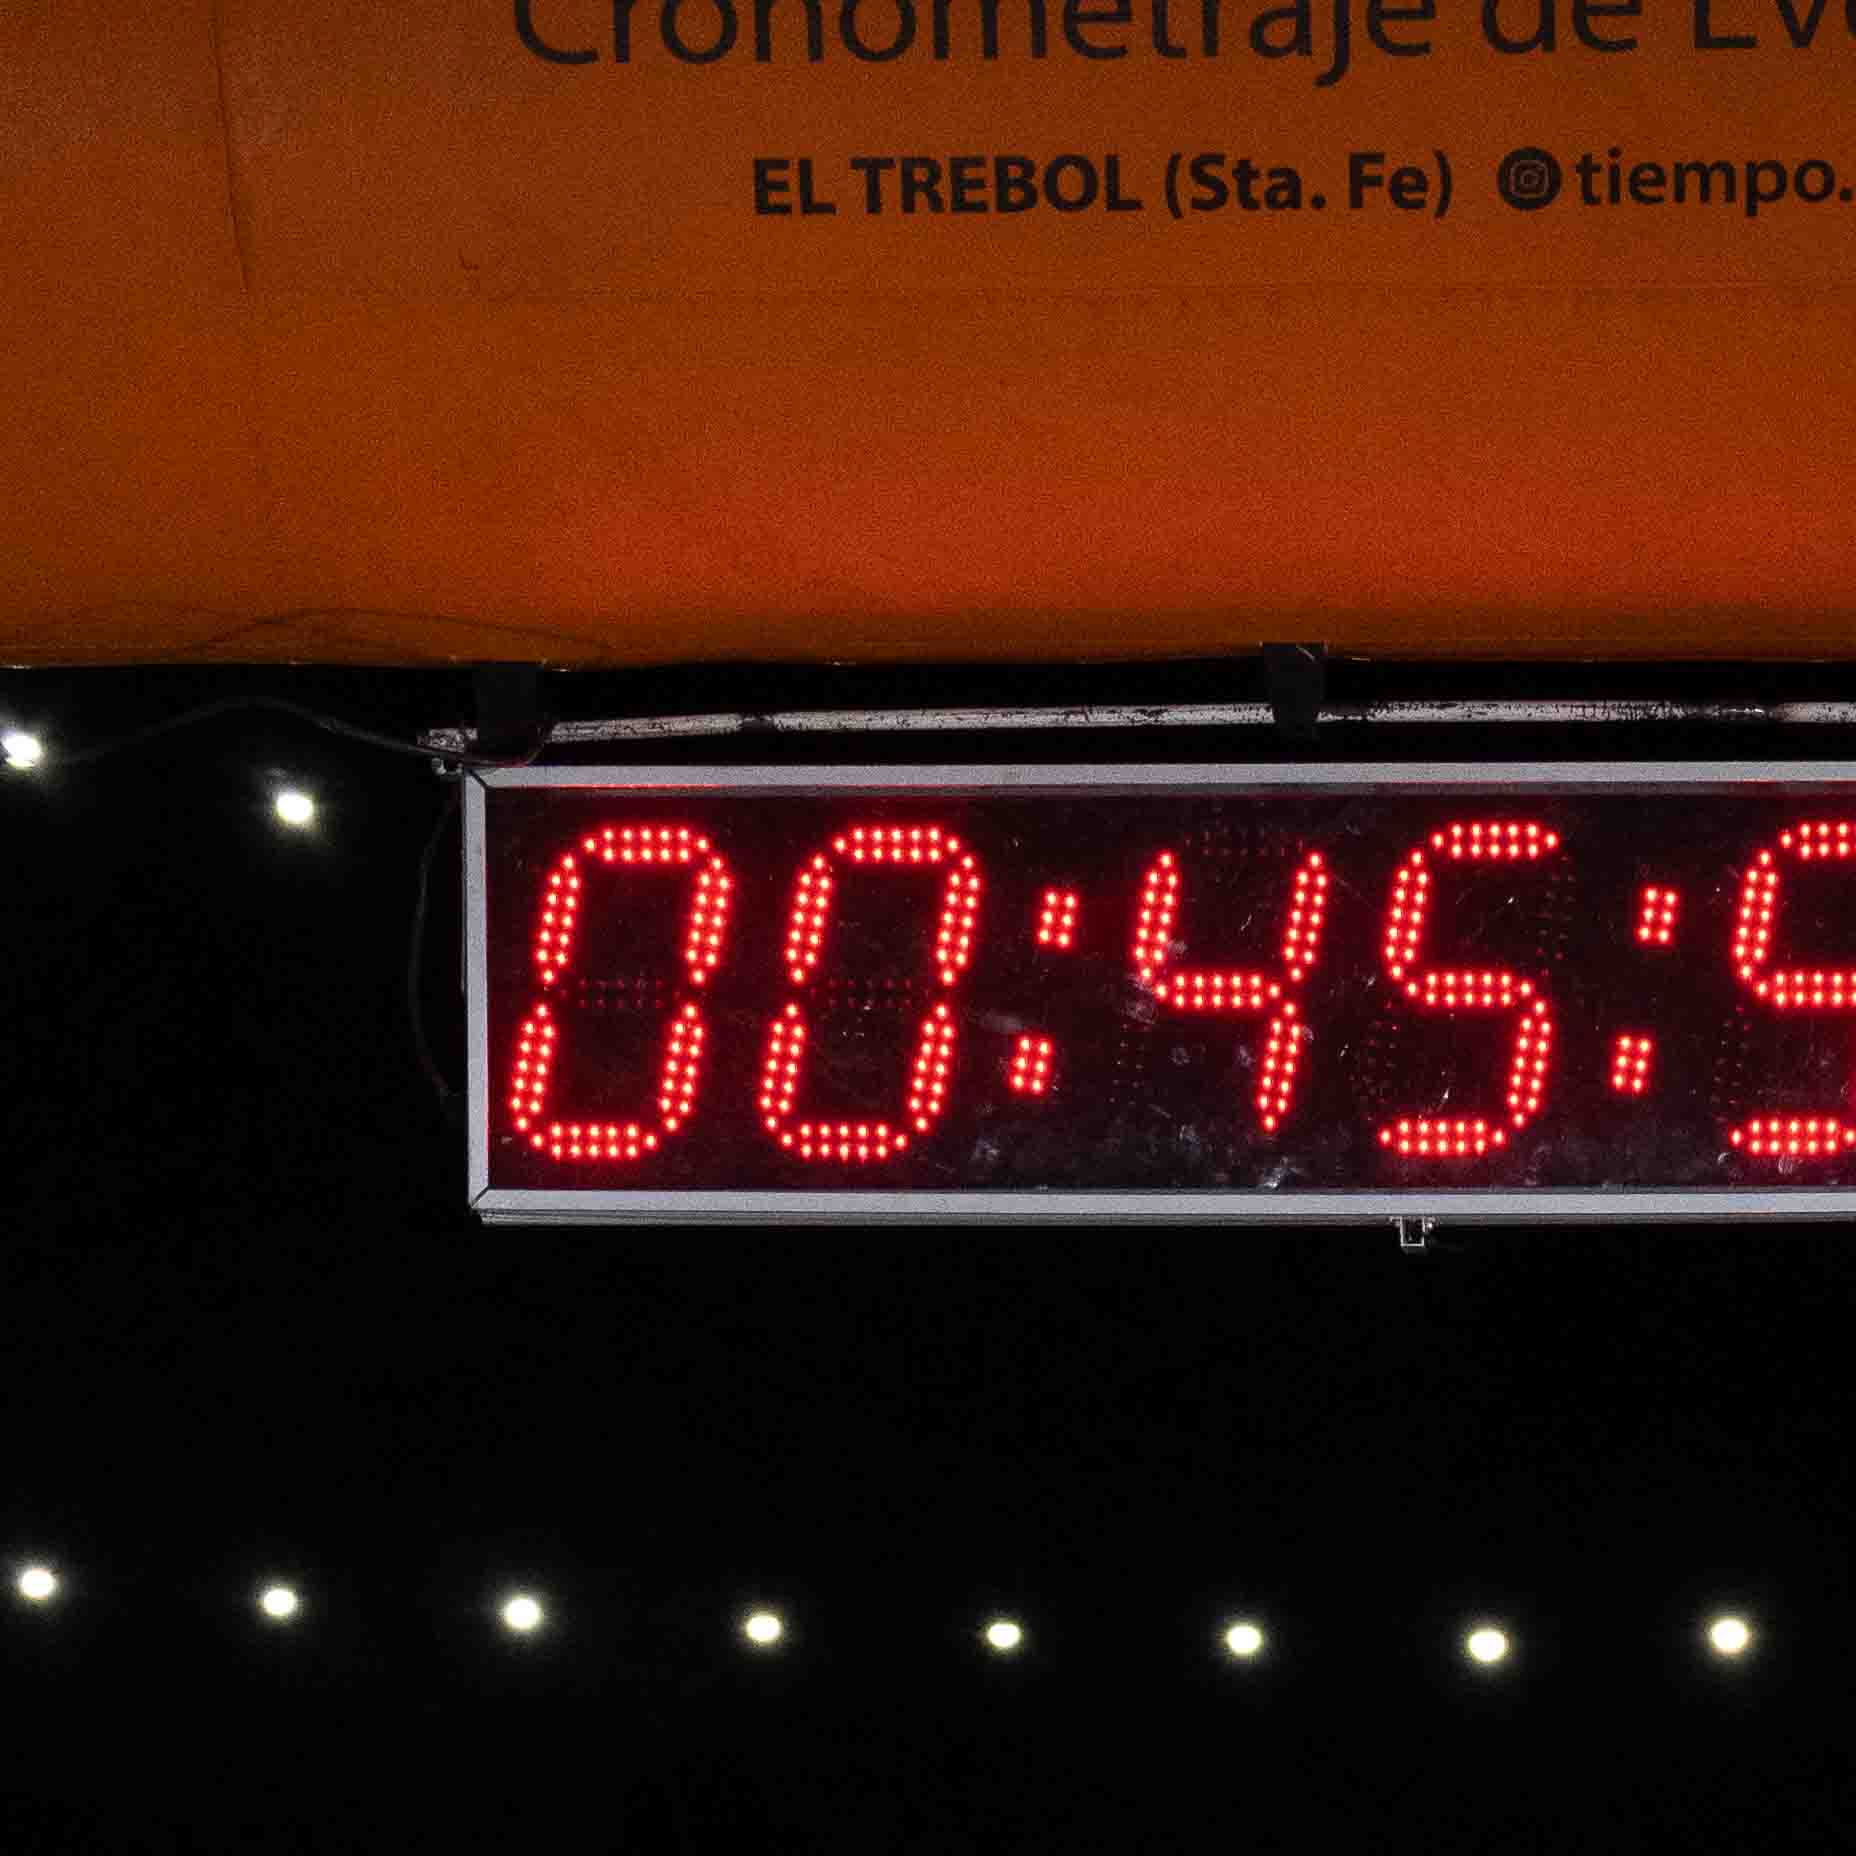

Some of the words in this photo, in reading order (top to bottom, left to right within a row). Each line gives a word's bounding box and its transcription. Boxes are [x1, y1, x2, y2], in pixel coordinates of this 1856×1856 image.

[513, 0, 1436, 88] Cronometraje
[753, 157, 837, 216] EL
[850, 153, 1145, 215] TREBOL
[1165, 152, 1327, 219] (Sta.
[1348, 148, 1453, 219] Fe)
